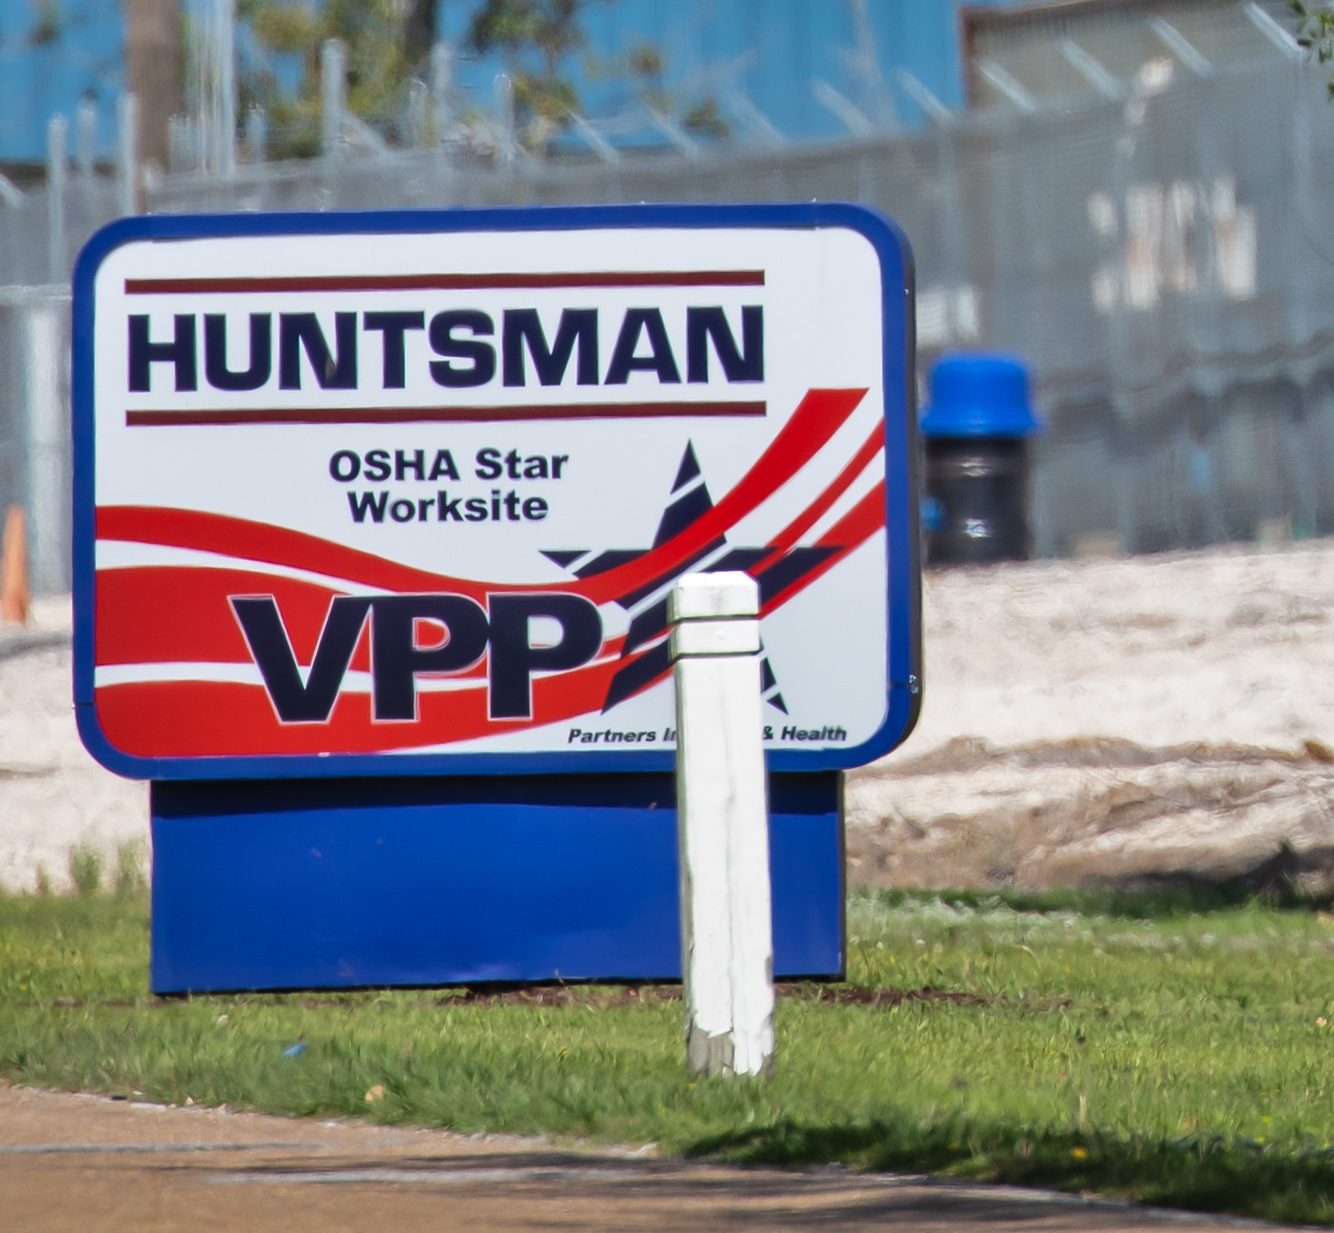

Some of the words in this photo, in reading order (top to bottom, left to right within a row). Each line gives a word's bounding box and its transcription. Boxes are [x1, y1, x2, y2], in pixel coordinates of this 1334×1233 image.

[126, 305, 766, 393] HUNTSMAN
[328, 449, 461, 482] OSHA
[475, 447, 569, 481] Star
[346, 489, 550, 523] Worksite
[227, 592, 603, 724] VPP
[568, 728, 656, 743] Partners
[781, 726, 847, 741] Health
